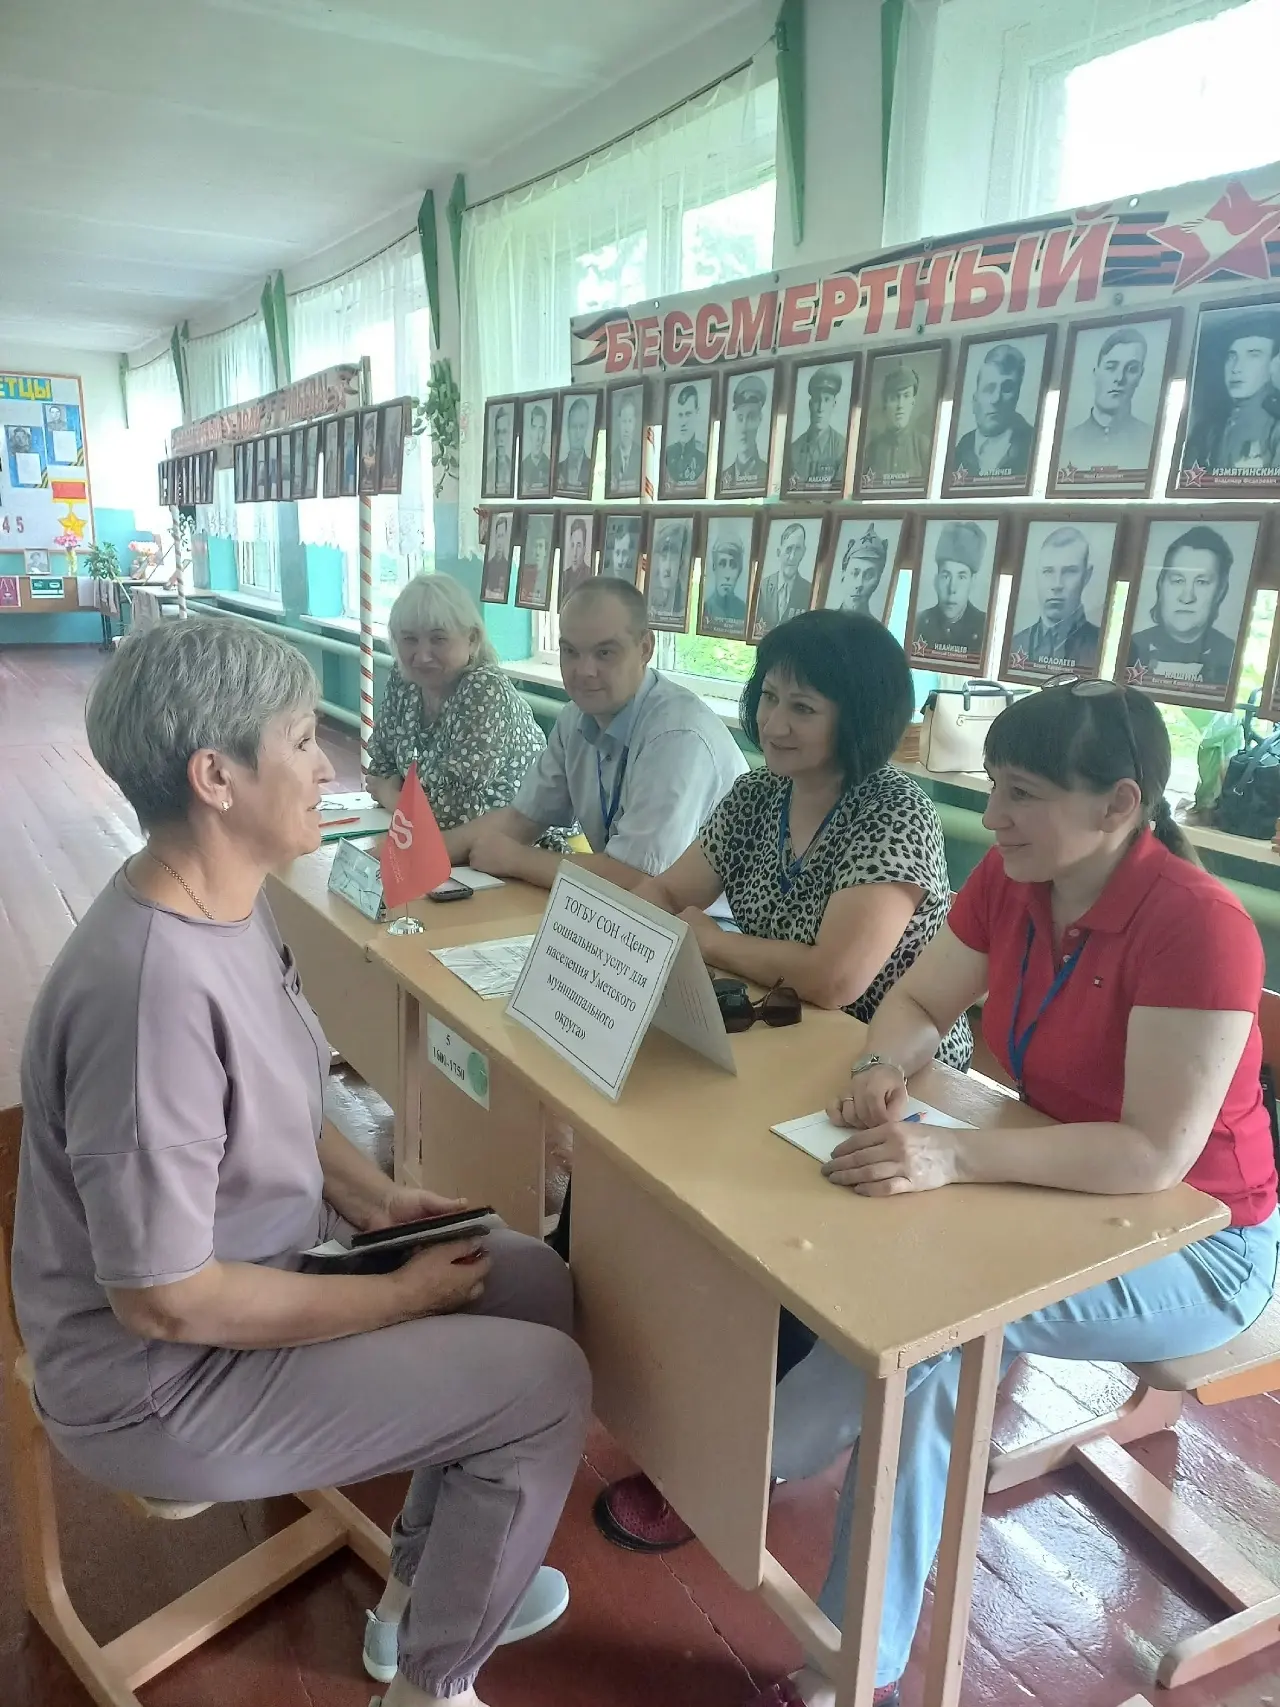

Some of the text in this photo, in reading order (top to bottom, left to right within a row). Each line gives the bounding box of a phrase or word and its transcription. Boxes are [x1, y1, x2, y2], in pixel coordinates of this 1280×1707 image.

[604, 204, 1120, 375] БЕССМЕРТНЫЙ
[1211, 466, 1280, 477] ИЗМЯТИНСКИЙ
[553, 920, 648, 988] социальных услуг для
[564, 895, 656, 963] ТОГБУ СОН «Центр
[546, 945, 590, 980] населения
[589, 969, 637, 1013] Уметского
[547, 973, 615, 1031] муниципального
[445, 1034, 451, 1046] 5
[554, 1010, 587, 1041] округа»
